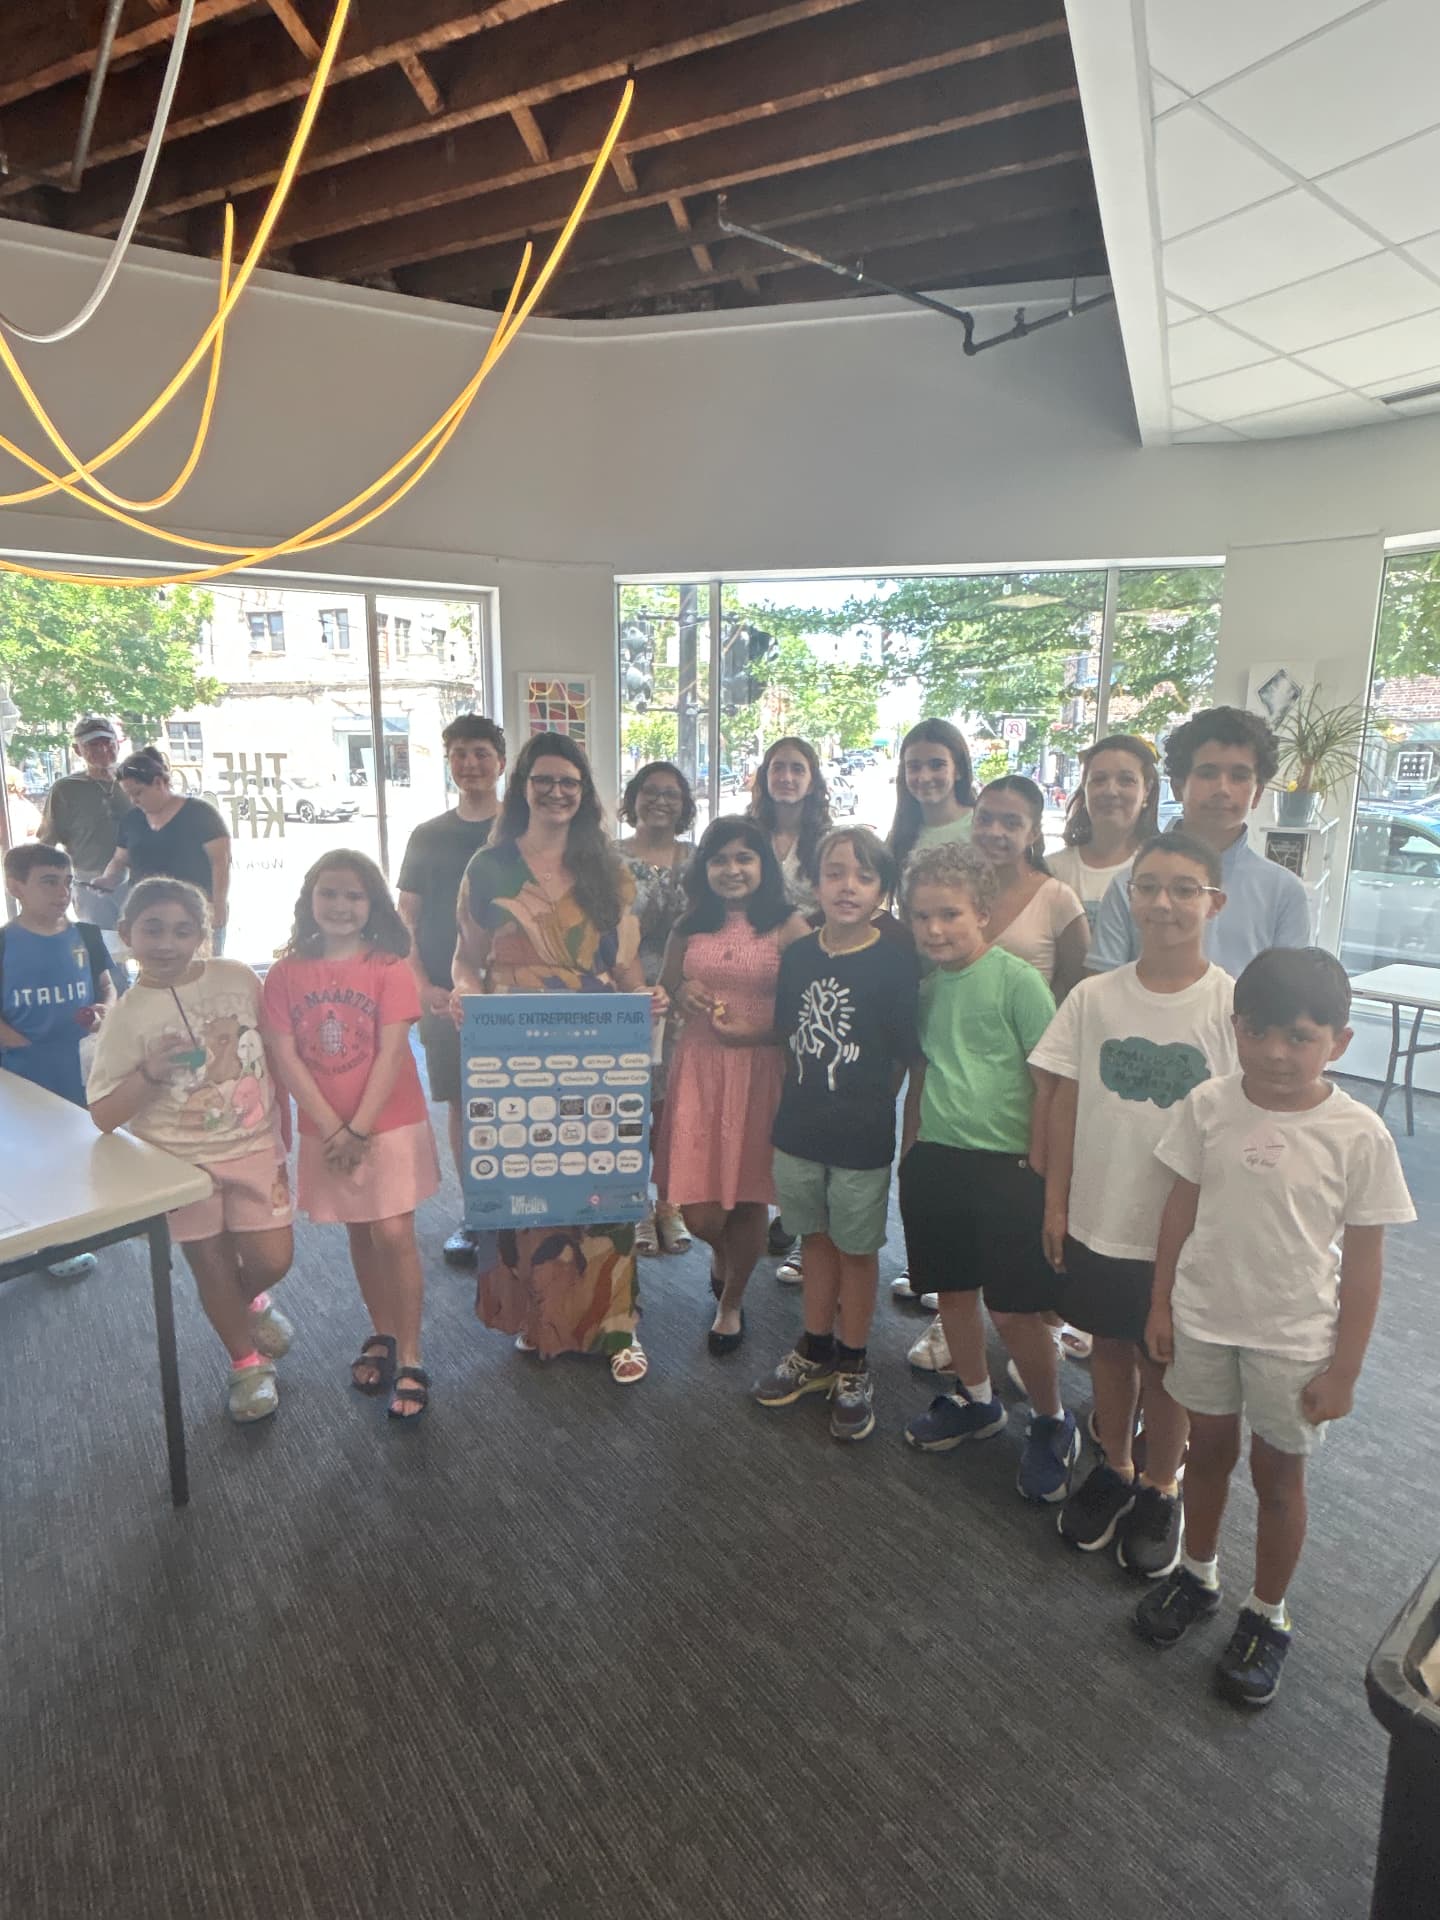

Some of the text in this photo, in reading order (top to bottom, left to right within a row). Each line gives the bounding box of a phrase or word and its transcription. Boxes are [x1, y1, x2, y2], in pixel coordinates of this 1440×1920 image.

[13, 982, 86, 1008] ITALIA
[472, 1011, 645, 1026] YOUNG ENTREPRENEUR FAIR
